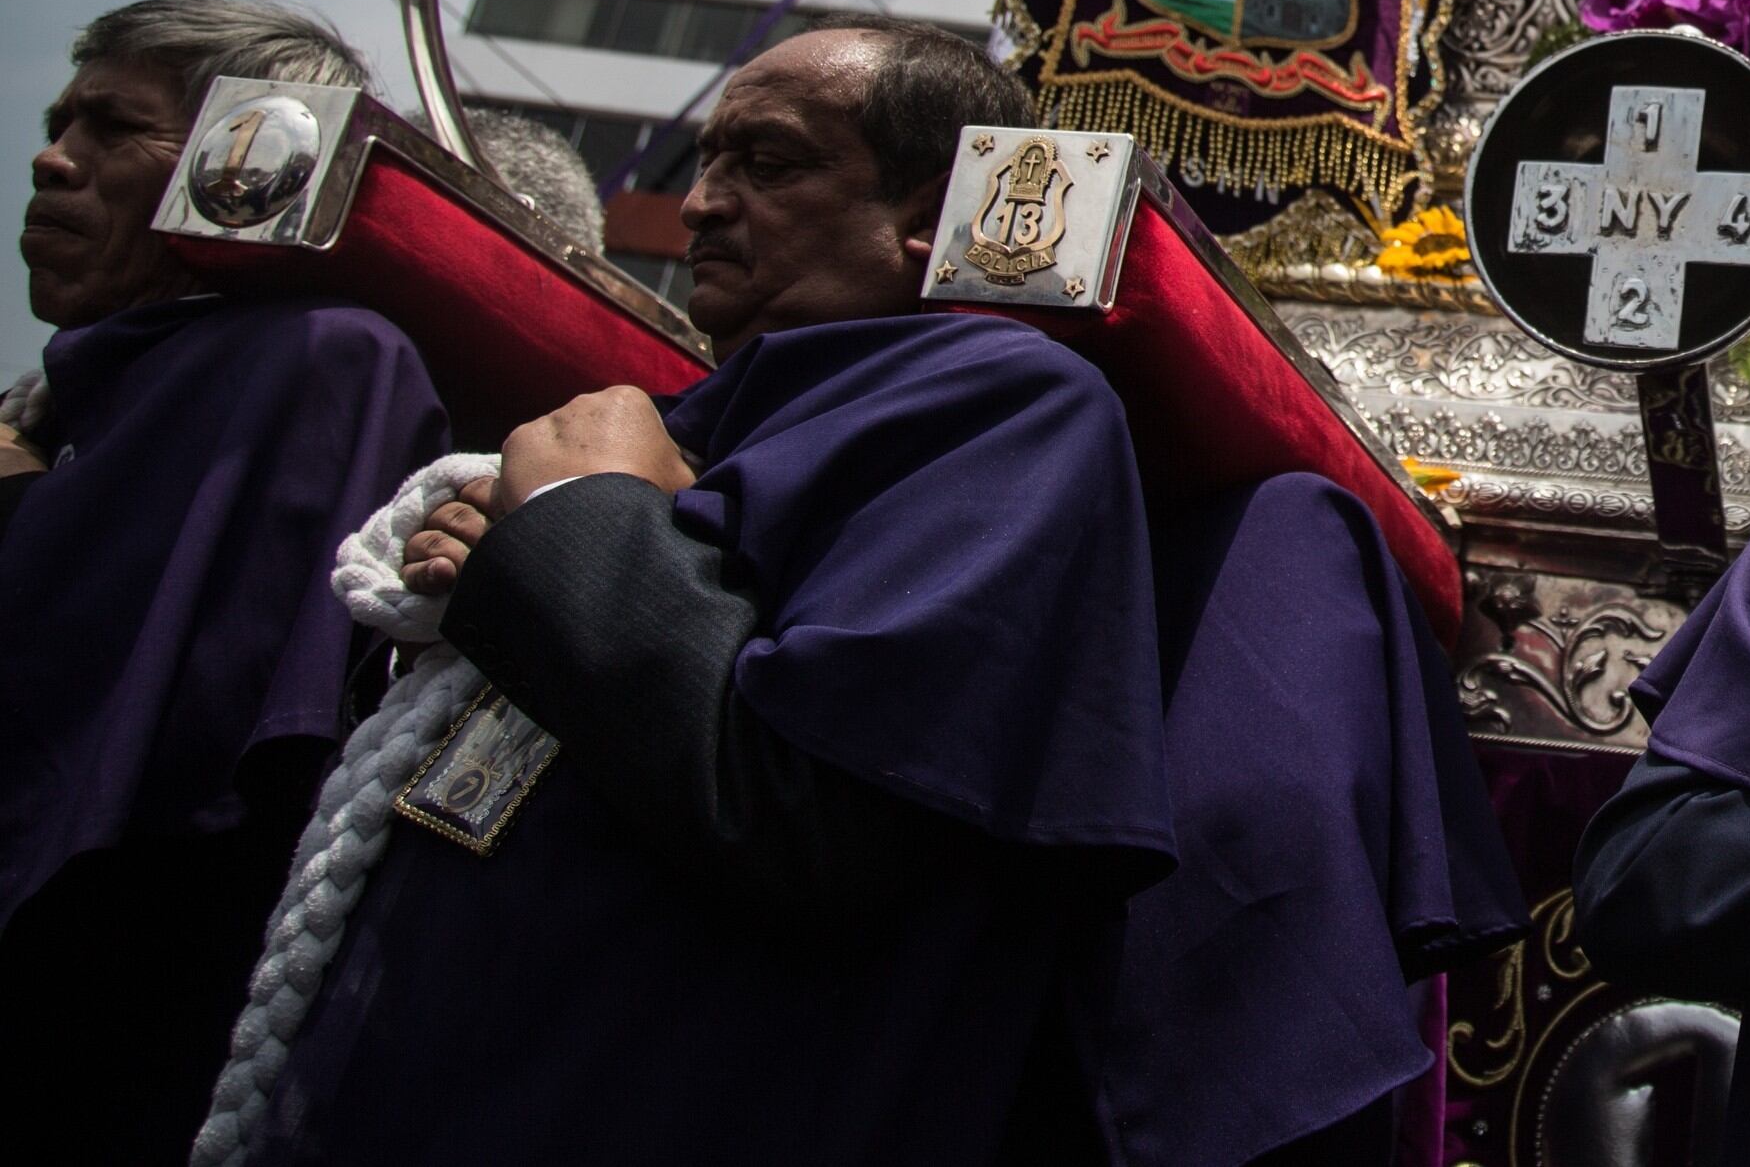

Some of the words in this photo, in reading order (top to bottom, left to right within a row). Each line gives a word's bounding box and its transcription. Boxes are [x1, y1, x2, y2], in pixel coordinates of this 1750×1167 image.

[1637, 101, 1662, 152] 1
[207, 110, 265, 196] 1
[997, 201, 1042, 245] 13
[1537, 184, 1570, 231] 3
[1601, 188, 1691, 238] NY
[966, 244, 1052, 272] POLICIA
[1615, 278, 1649, 326] 2
